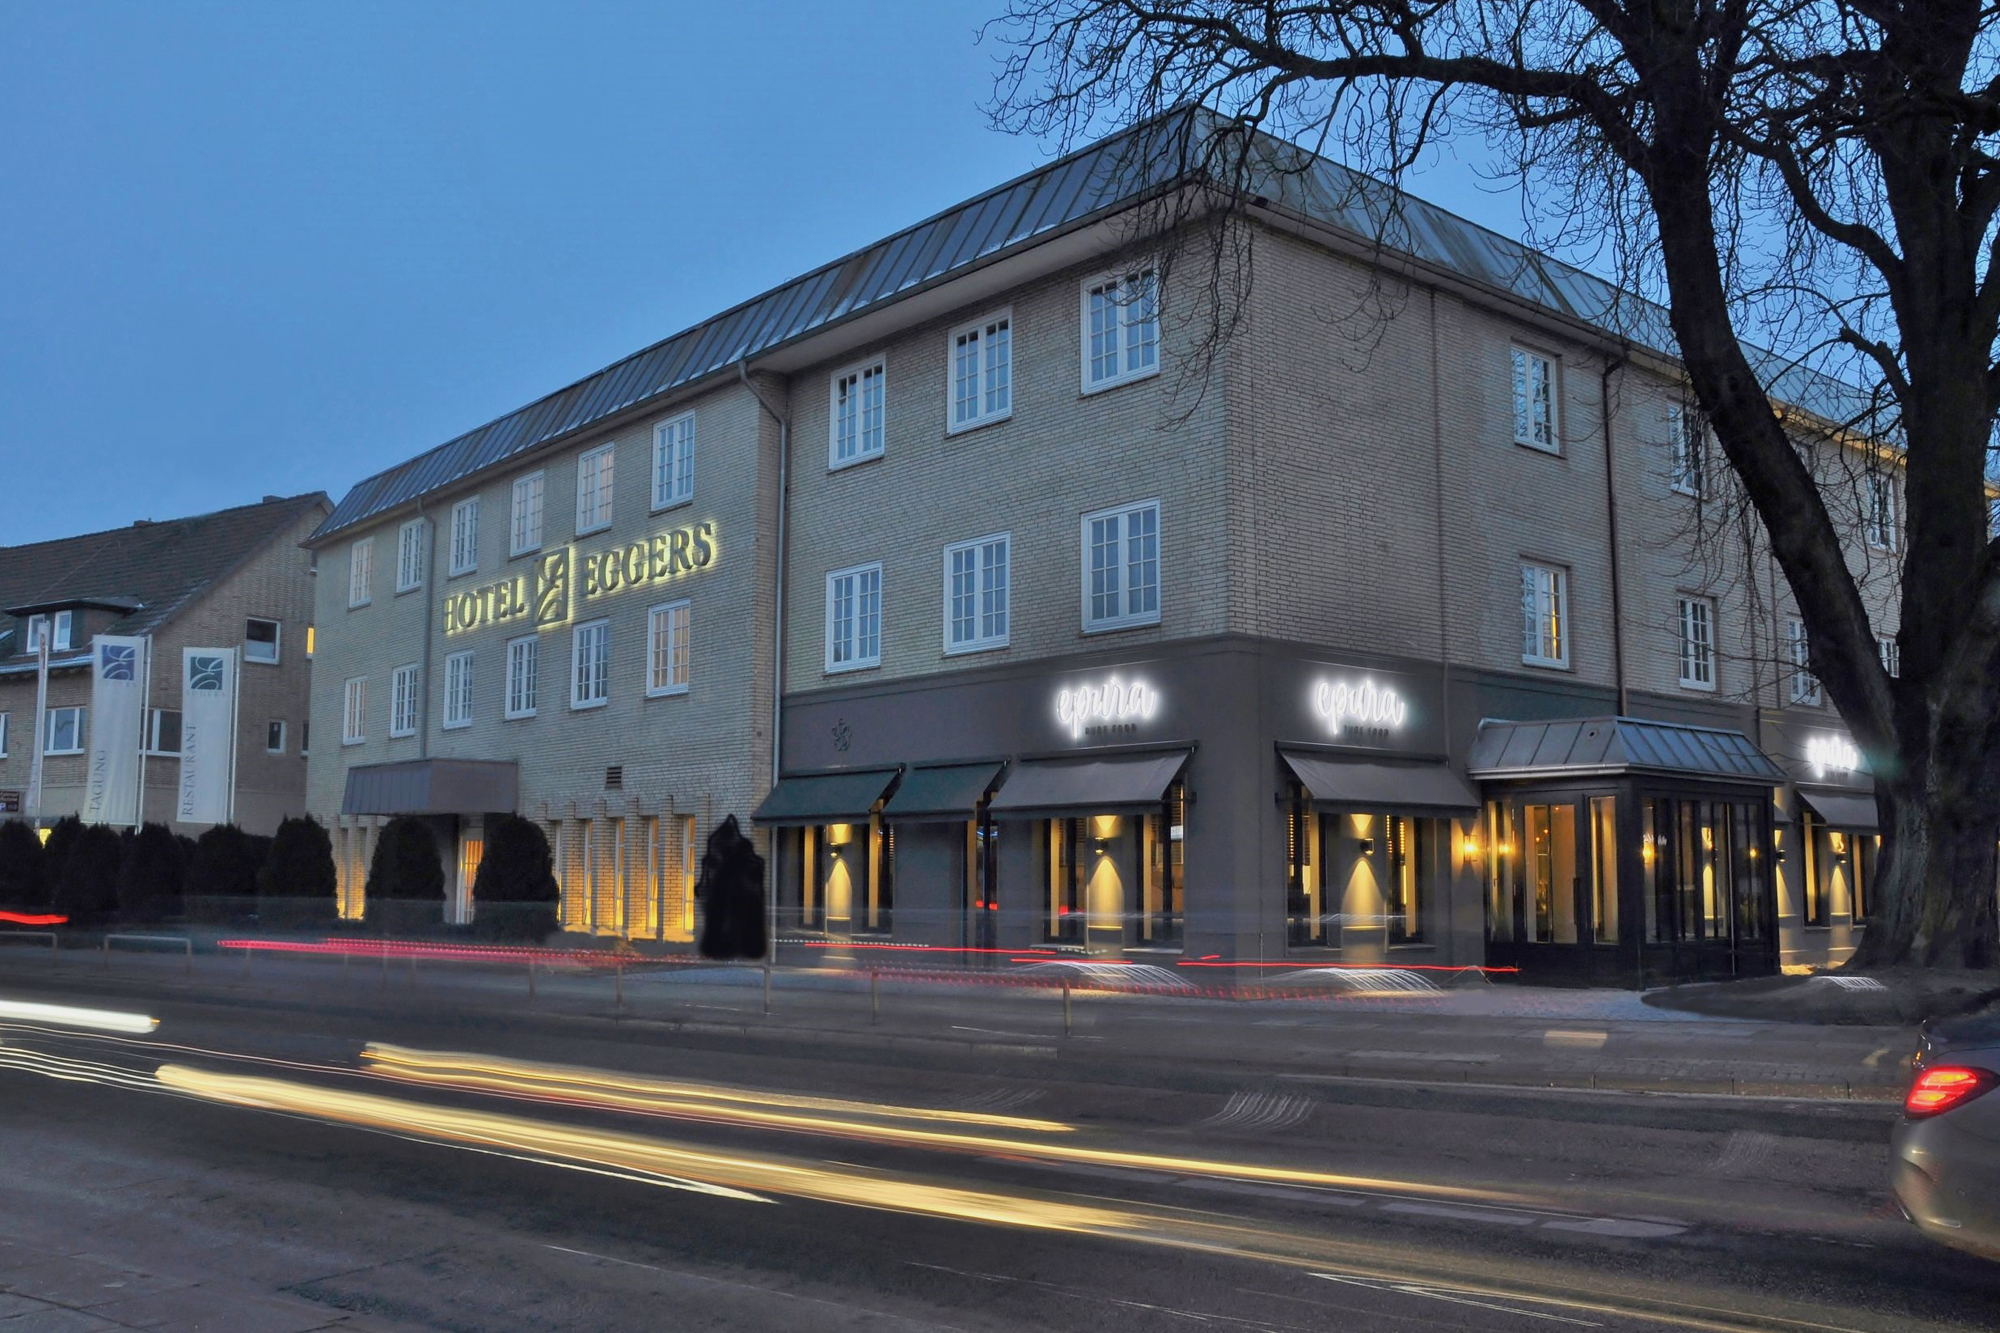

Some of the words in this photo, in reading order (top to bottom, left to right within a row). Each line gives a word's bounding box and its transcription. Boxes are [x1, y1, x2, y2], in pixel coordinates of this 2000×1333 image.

[442, 577, 525, 632] HOTEL
[582, 522, 713, 596] EGGERS
[1056, 676, 1157, 739] epura
[1316, 679, 1406, 736] epura
[89, 750, 107, 813] TAGUNG
[181, 723, 197, 816] RESTAURANT
